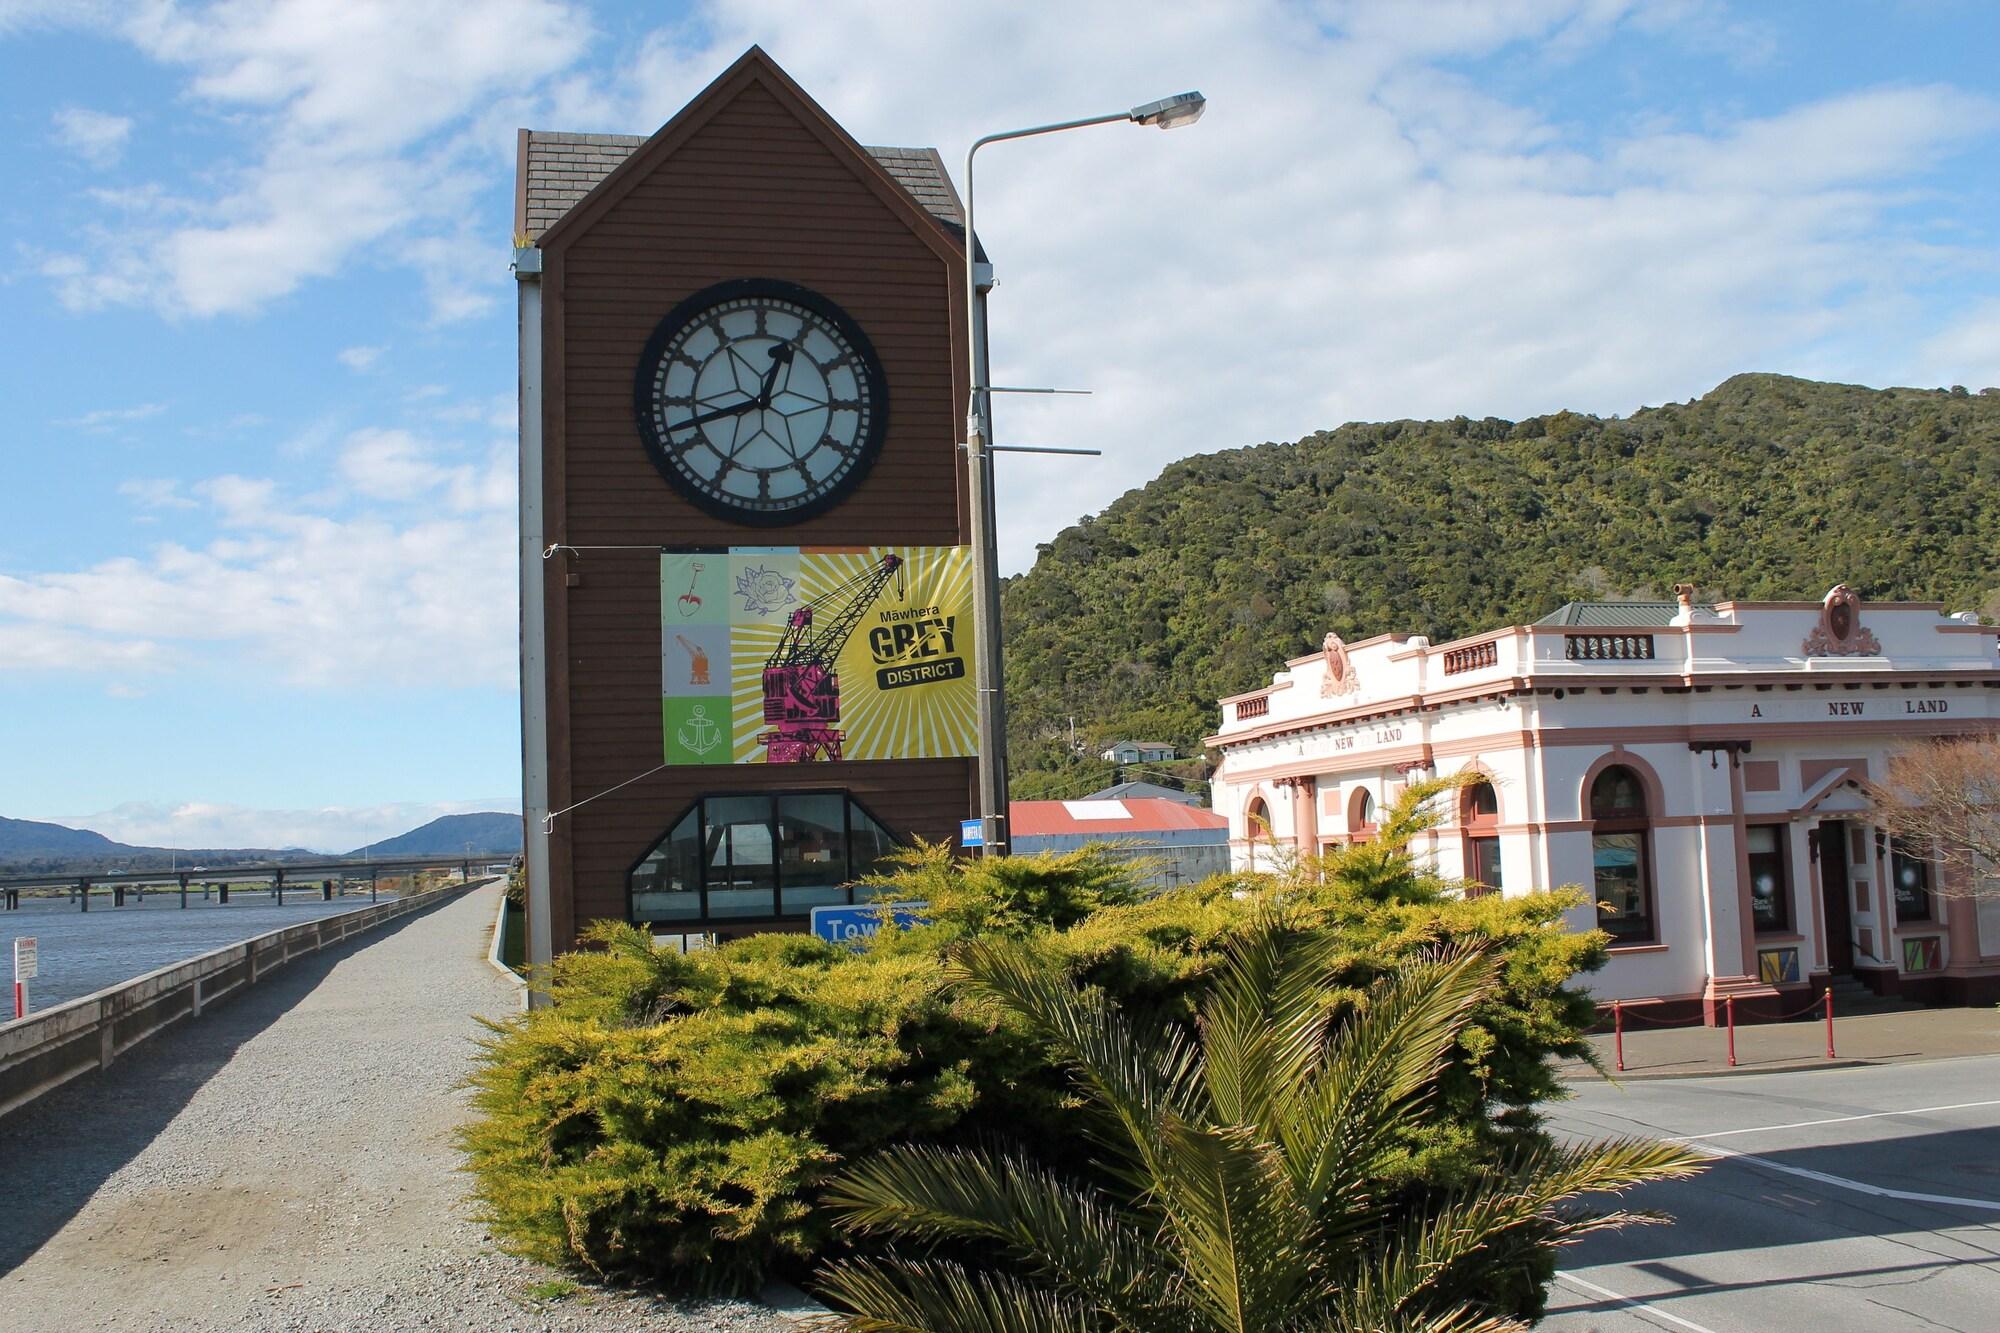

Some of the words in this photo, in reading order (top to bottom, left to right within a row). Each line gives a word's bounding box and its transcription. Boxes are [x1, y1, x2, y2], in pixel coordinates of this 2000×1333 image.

[869, 616, 955, 664] GREY
[887, 662, 954, 684] DISTRICT
[1751, 704, 1762, 718] A
[1828, 702, 1864, 715] NEW
[1906, 700, 1948, 714] LAND
[1298, 744, 1304, 757] A
[1335, 736, 1354, 750] NEW
[1376, 728, 1402, 744] LAND
[827, 919, 882, 941] Tow
